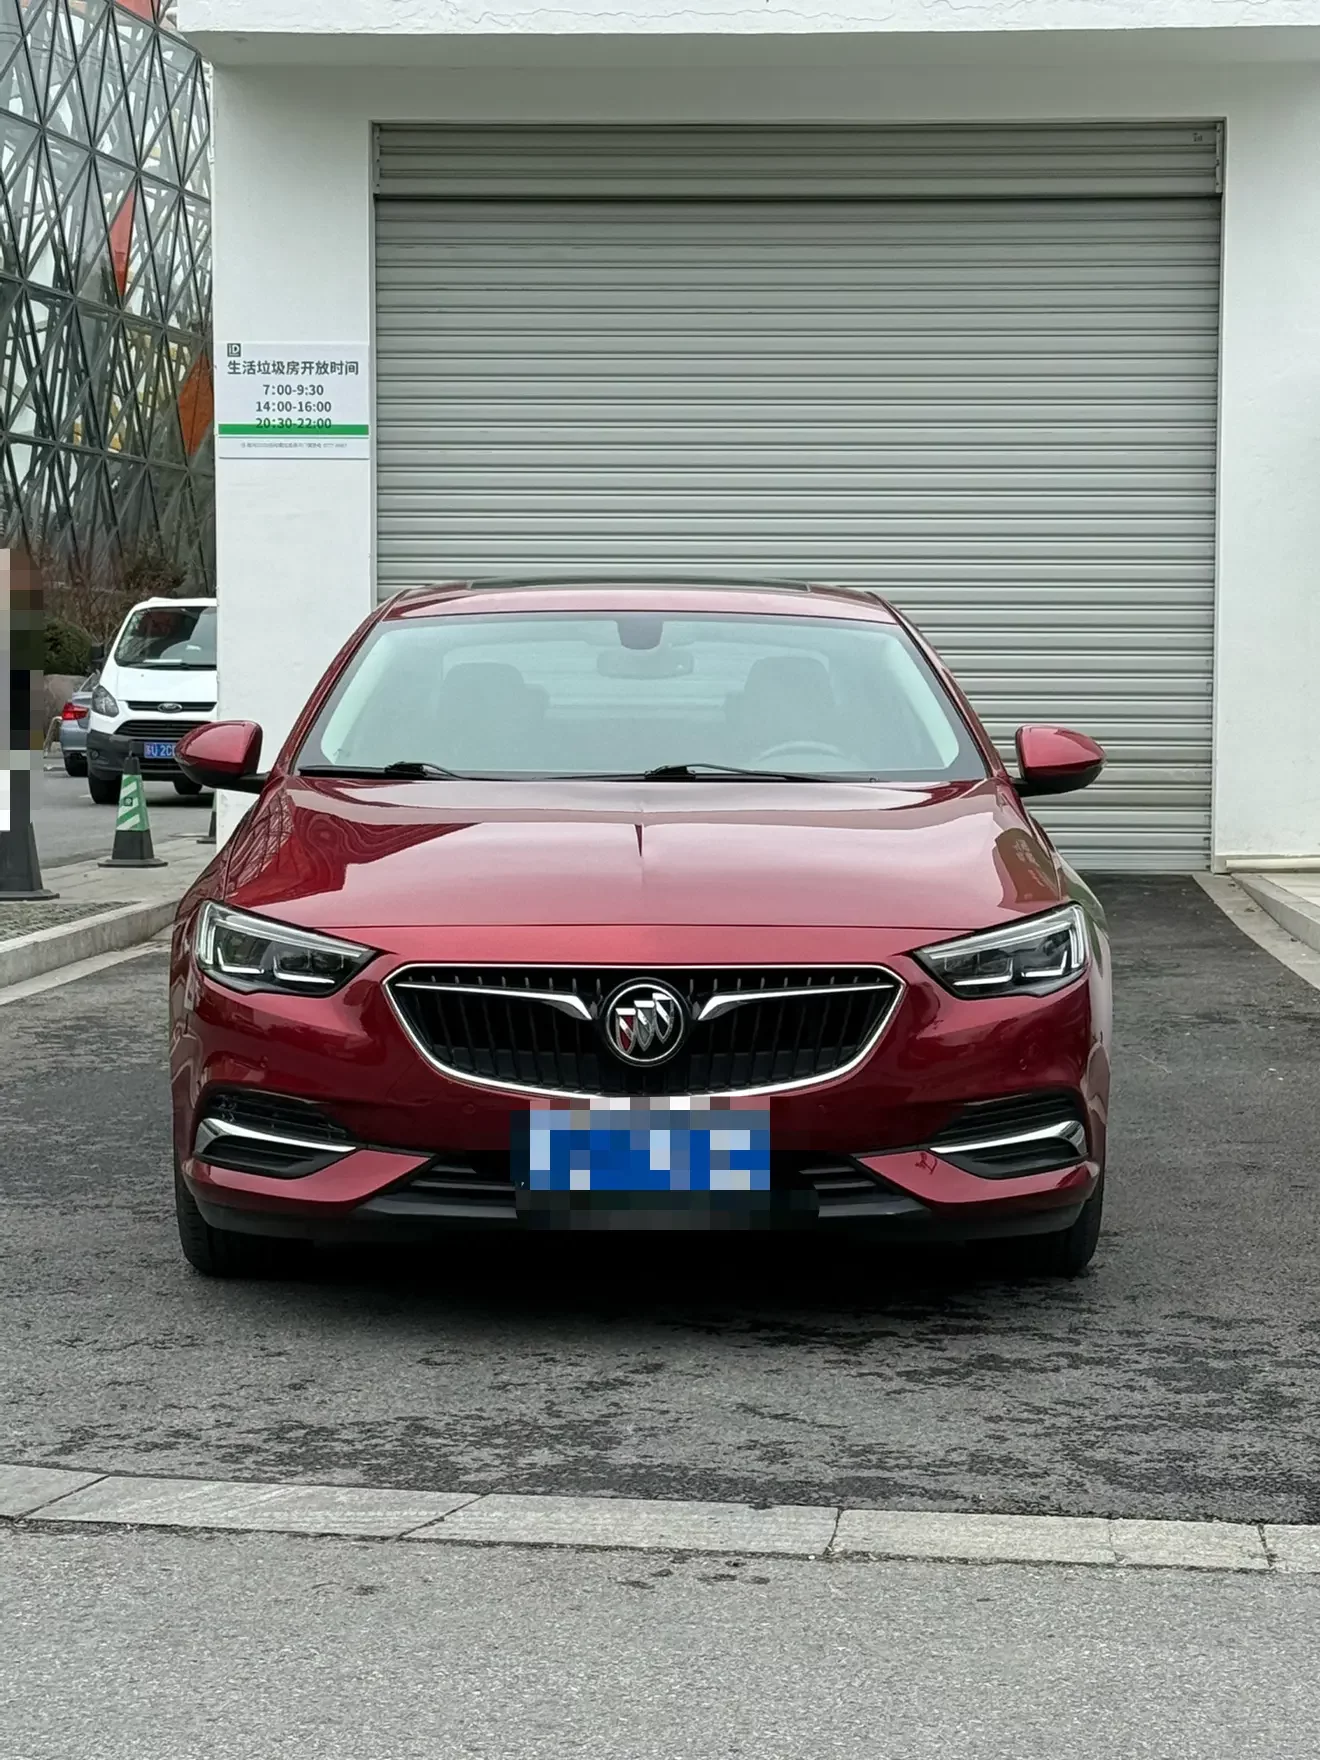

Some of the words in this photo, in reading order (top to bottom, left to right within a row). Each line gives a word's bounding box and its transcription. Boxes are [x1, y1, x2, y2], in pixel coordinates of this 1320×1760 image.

[227, 360, 359, 375] 生活垃圾房开放时间
[263, 384, 324, 395] 7:00-9:30
[255, 401, 332, 412] 14:00-16:00
[255, 418, 332, 428] 20:30-22:00
